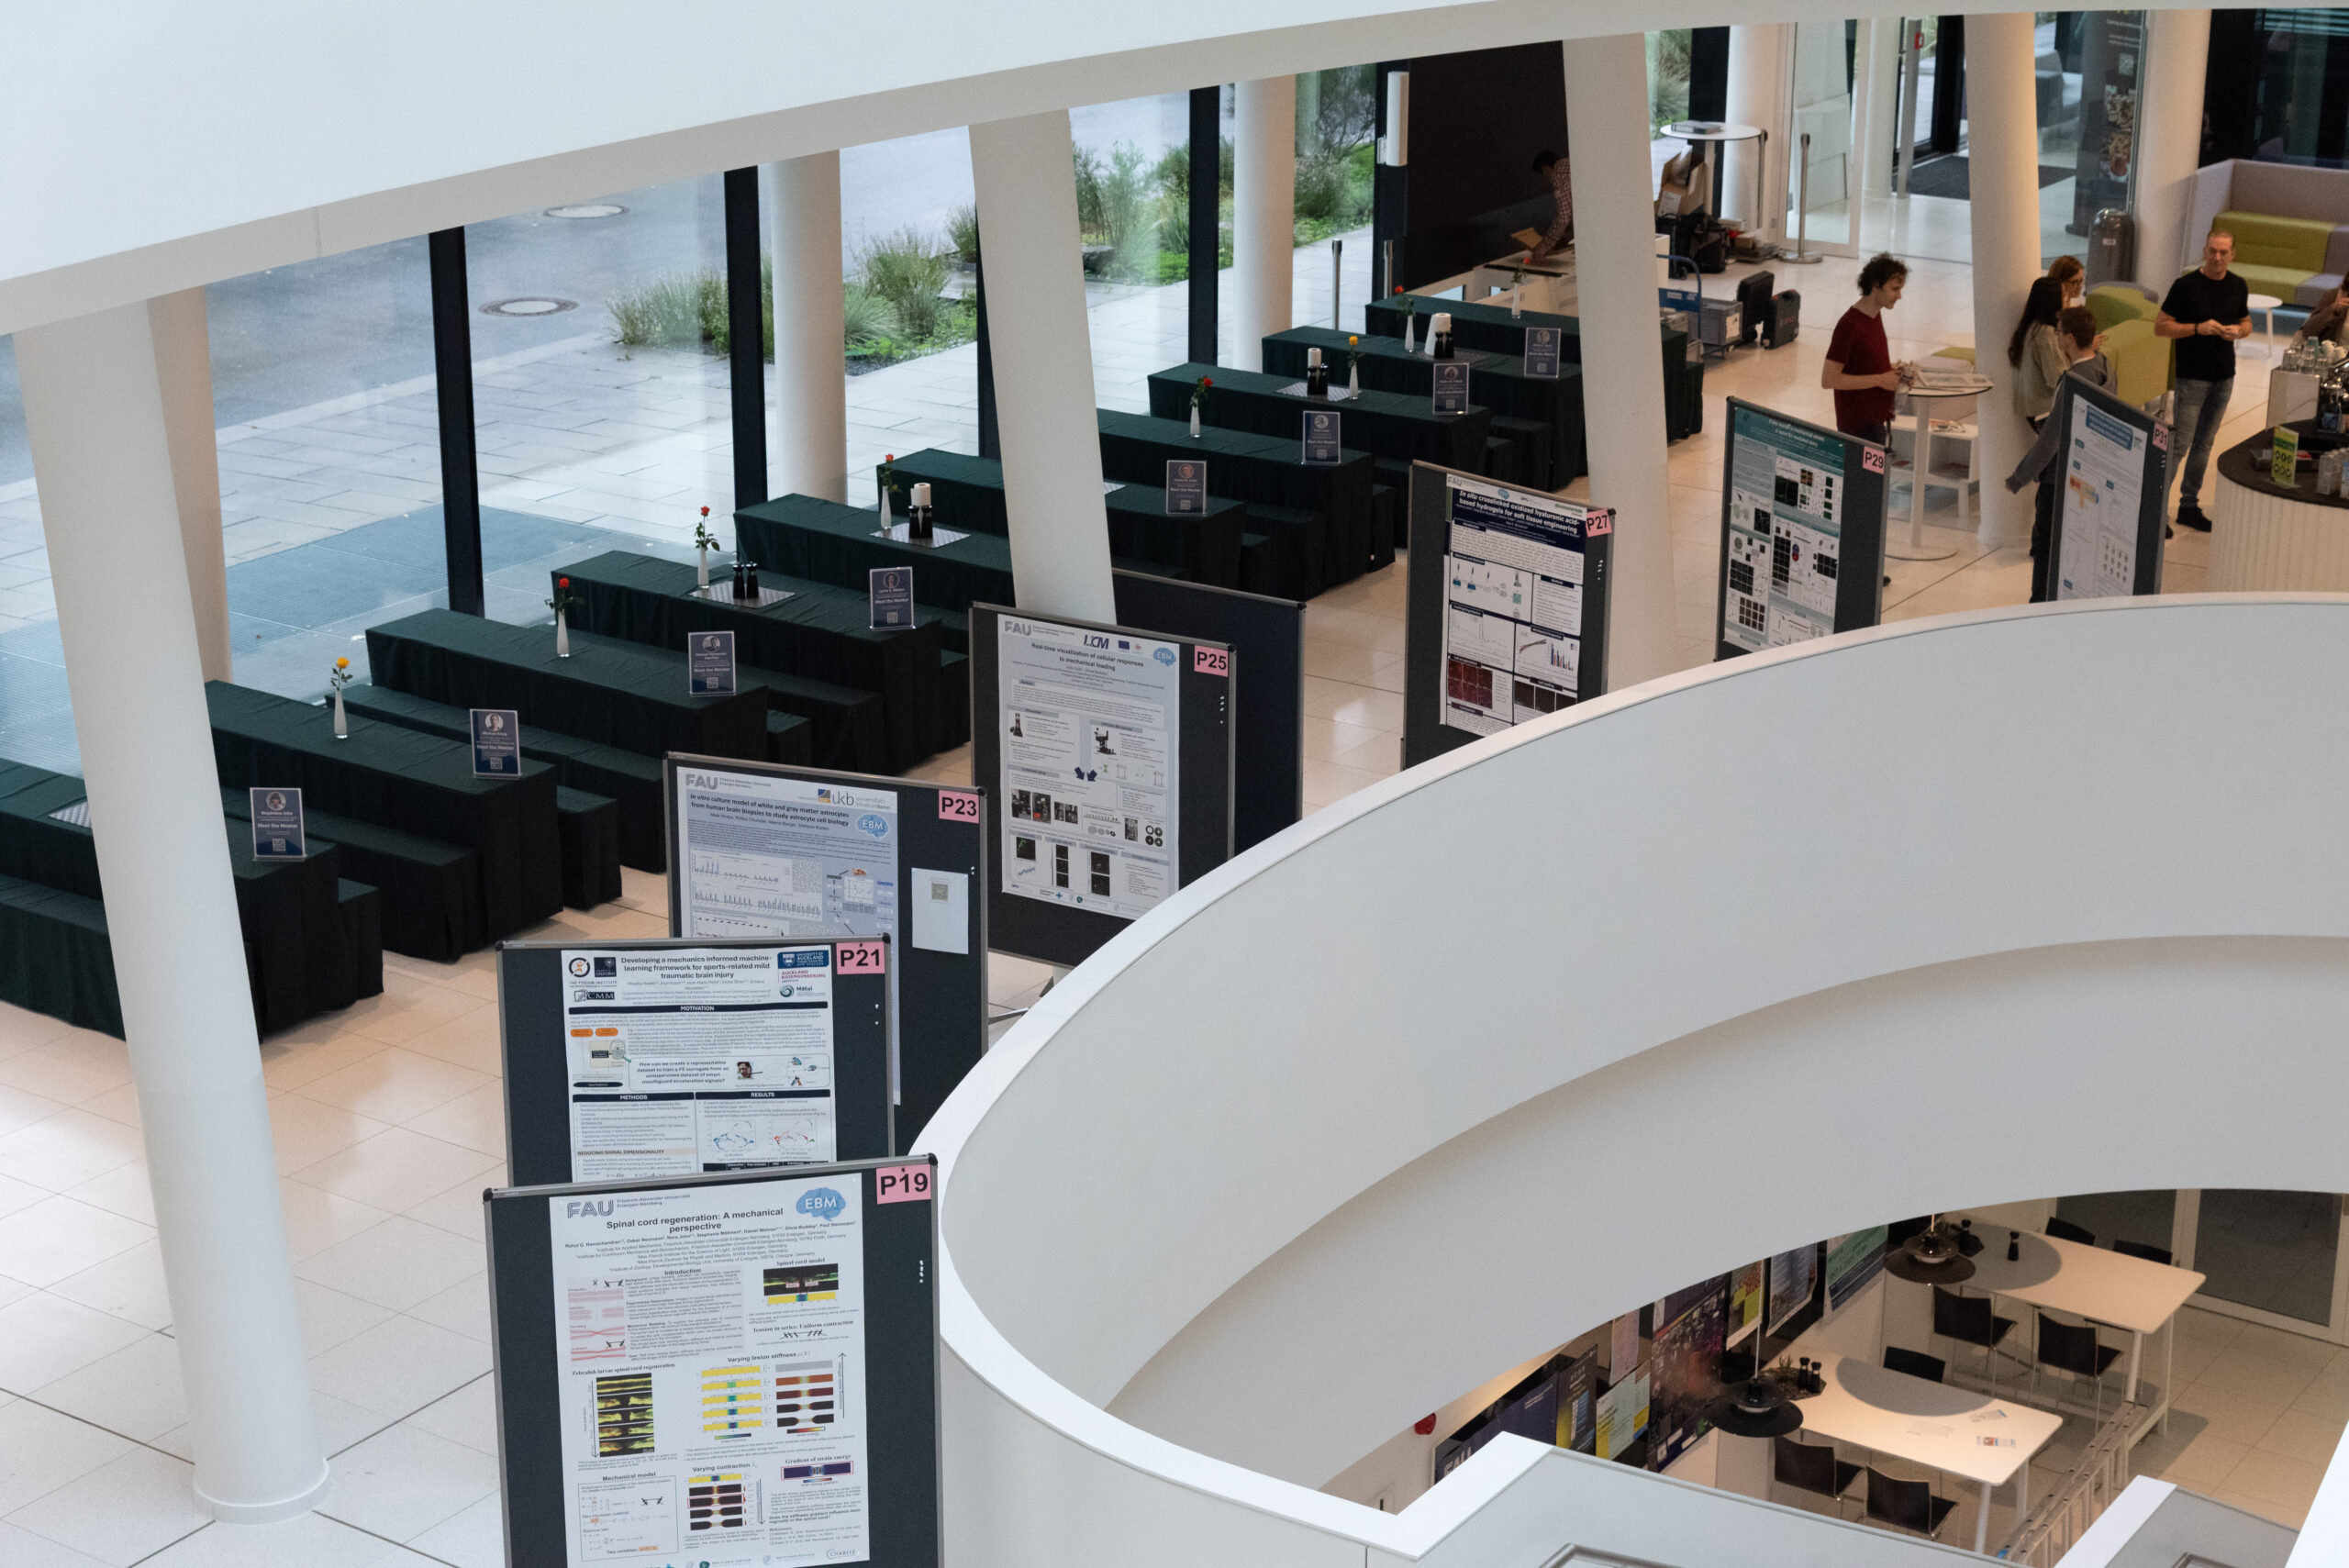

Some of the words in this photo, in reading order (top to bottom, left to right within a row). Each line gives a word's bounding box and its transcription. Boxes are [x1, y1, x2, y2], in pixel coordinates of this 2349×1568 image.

[2154, 428, 2167, 445] P31
[1865, 451, 1884, 469] P29
[1466, 492, 1478, 500] situ
[1478, 496, 1510, 507] crosslinked
[1510, 504, 1533, 514] oxidized
[1534, 509, 1564, 522] hyaluronic
[1459, 498, 1475, 506] based
[1476, 503, 1504, 514] hydrogels
[1526, 515, 1542, 524] tissue
[1543, 519, 1577, 534] engineering
[1586, 515, 1608, 532] P27
[1005, 621, 1031, 636] FAU
[1031, 643, 1055, 651] Real-time
[1057, 648, 1089, 657] visualization
[1117, 659, 1143, 667] responses
[1157, 652, 1172, 661] EBM
[1197, 651, 1227, 670] P25
[1065, 658, 1095, 667] mechanical
[1096, 662, 1116, 671] loading
[685, 773, 718, 790] FAU
[832, 791, 854, 806] ukb
[941, 796, 977, 817] P23
[741, 808, 764, 817] biopsies
[789, 815, 816, 823] astrocyte
[828, 818, 849, 827] biology
[819, 810, 850, 818] astrocytes
[863, 820, 884, 829] EBM
[841, 949, 880, 967] P21
[715, 972, 734, 980] injury
[880, 1173, 929, 1195] P19
[566, 1199, 614, 1219] FAU
[617, 1201, 662, 1209] Erlangen-Nürnberg
[805, 1196, 838, 1210] EBM
[607, 1220, 635, 1230] Spinal
[638, 1218, 658, 1228] cord
[661, 1213, 720, 1226] regeneration:
[723, 1212, 730, 1220] A
[731, 1207, 783, 1219] mechanical
[670, 1222, 721, 1234] perspective
